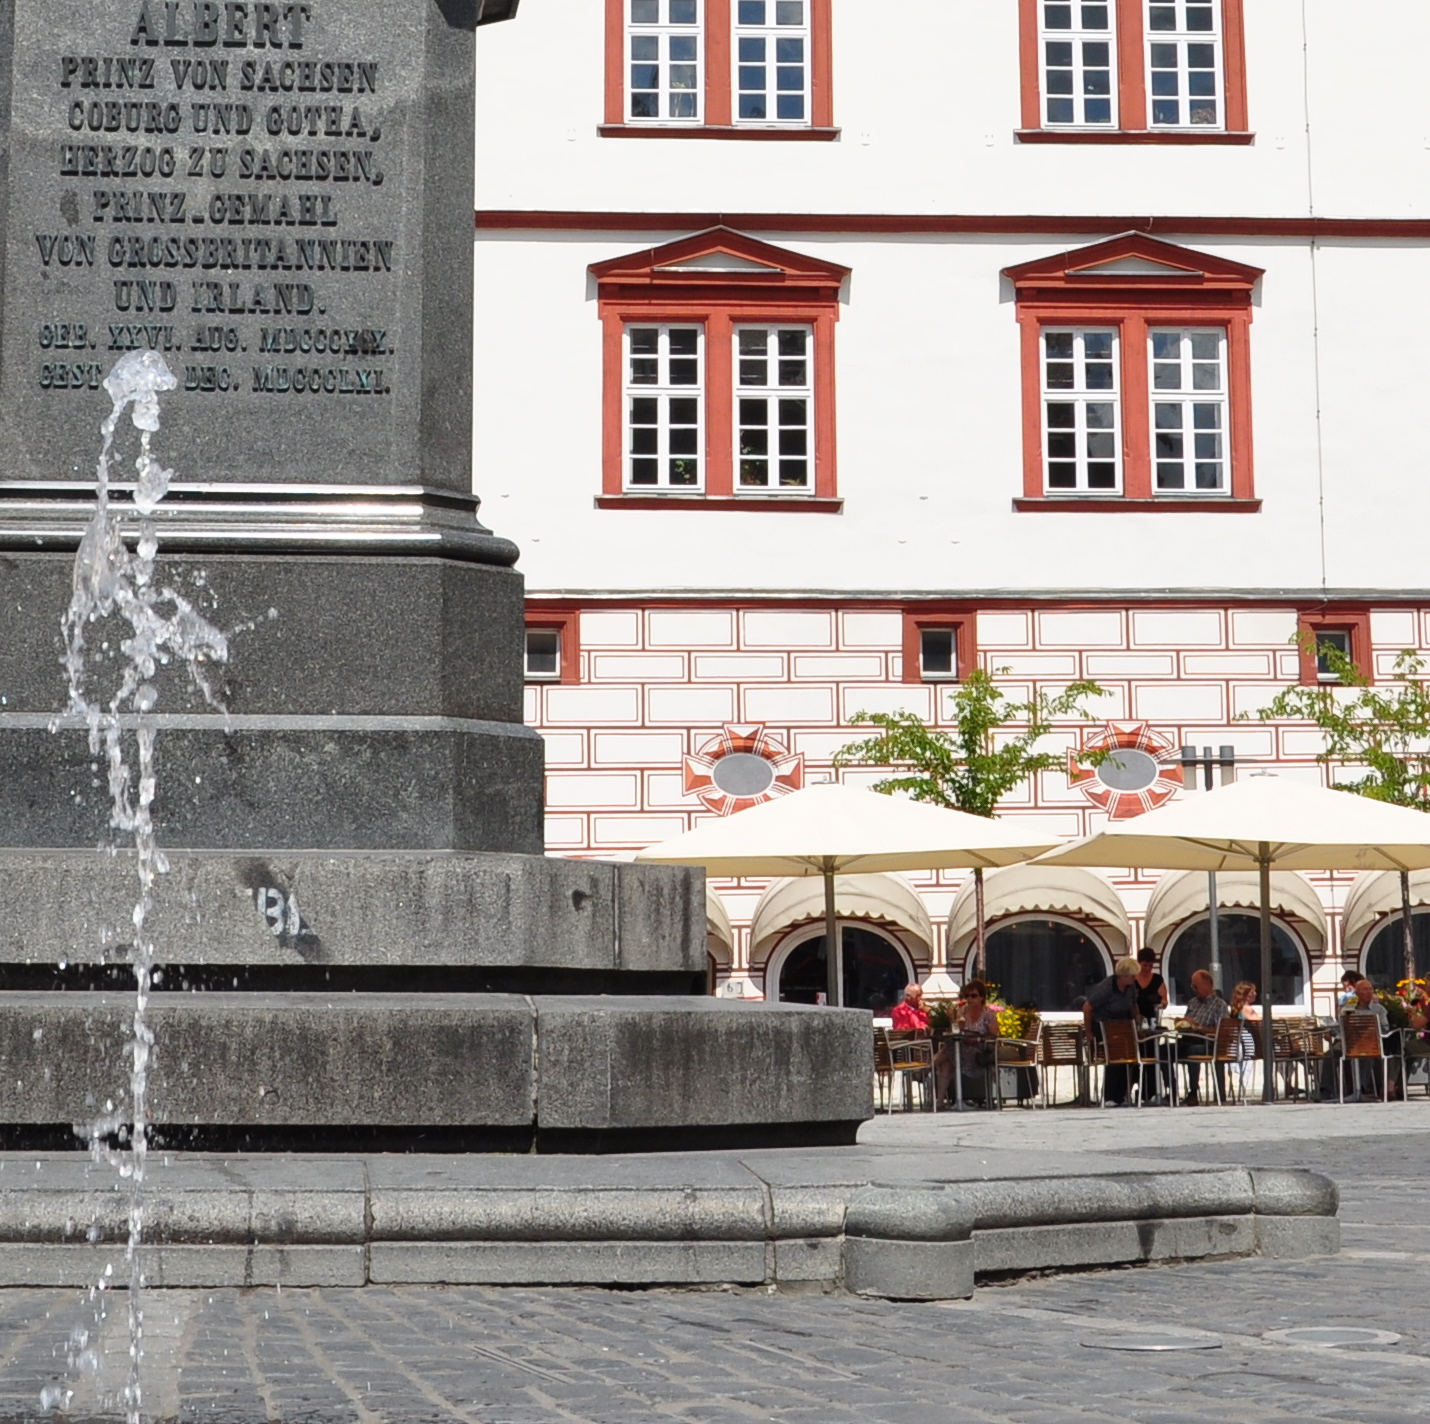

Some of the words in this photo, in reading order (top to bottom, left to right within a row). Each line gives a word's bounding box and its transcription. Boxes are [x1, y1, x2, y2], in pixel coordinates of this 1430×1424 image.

[130, 0, 311, 49] ALBERT
[60, 56, 155, 89] PRINZ
[171, 58, 229, 91] VON
[240, 60, 378, 93] SACHSEN
[68, 100, 182, 134] COBURG
[191, 103, 253, 136] UND
[266, 104, 382, 142] GOTHA,
[60, 143, 177, 177] HERZOG
[187, 146, 228, 178] ZU
[239, 149, 384, 185] SACHSEN,
[36, 235, 96, 267] VON
[107, 235, 394, 272] GROSSBRITANNIEN
[113, 280, 177, 312] UND
[191, 281, 327, 315] IRLAND.
[38, 323, 97, 350] GEB.
[107, 324, 182, 351] XXVI.
[190, 326, 248, 353] AUG.
[184, 365, 240, 392] DEC.
[252, 366, 391, 394] MDCCCLXI.
